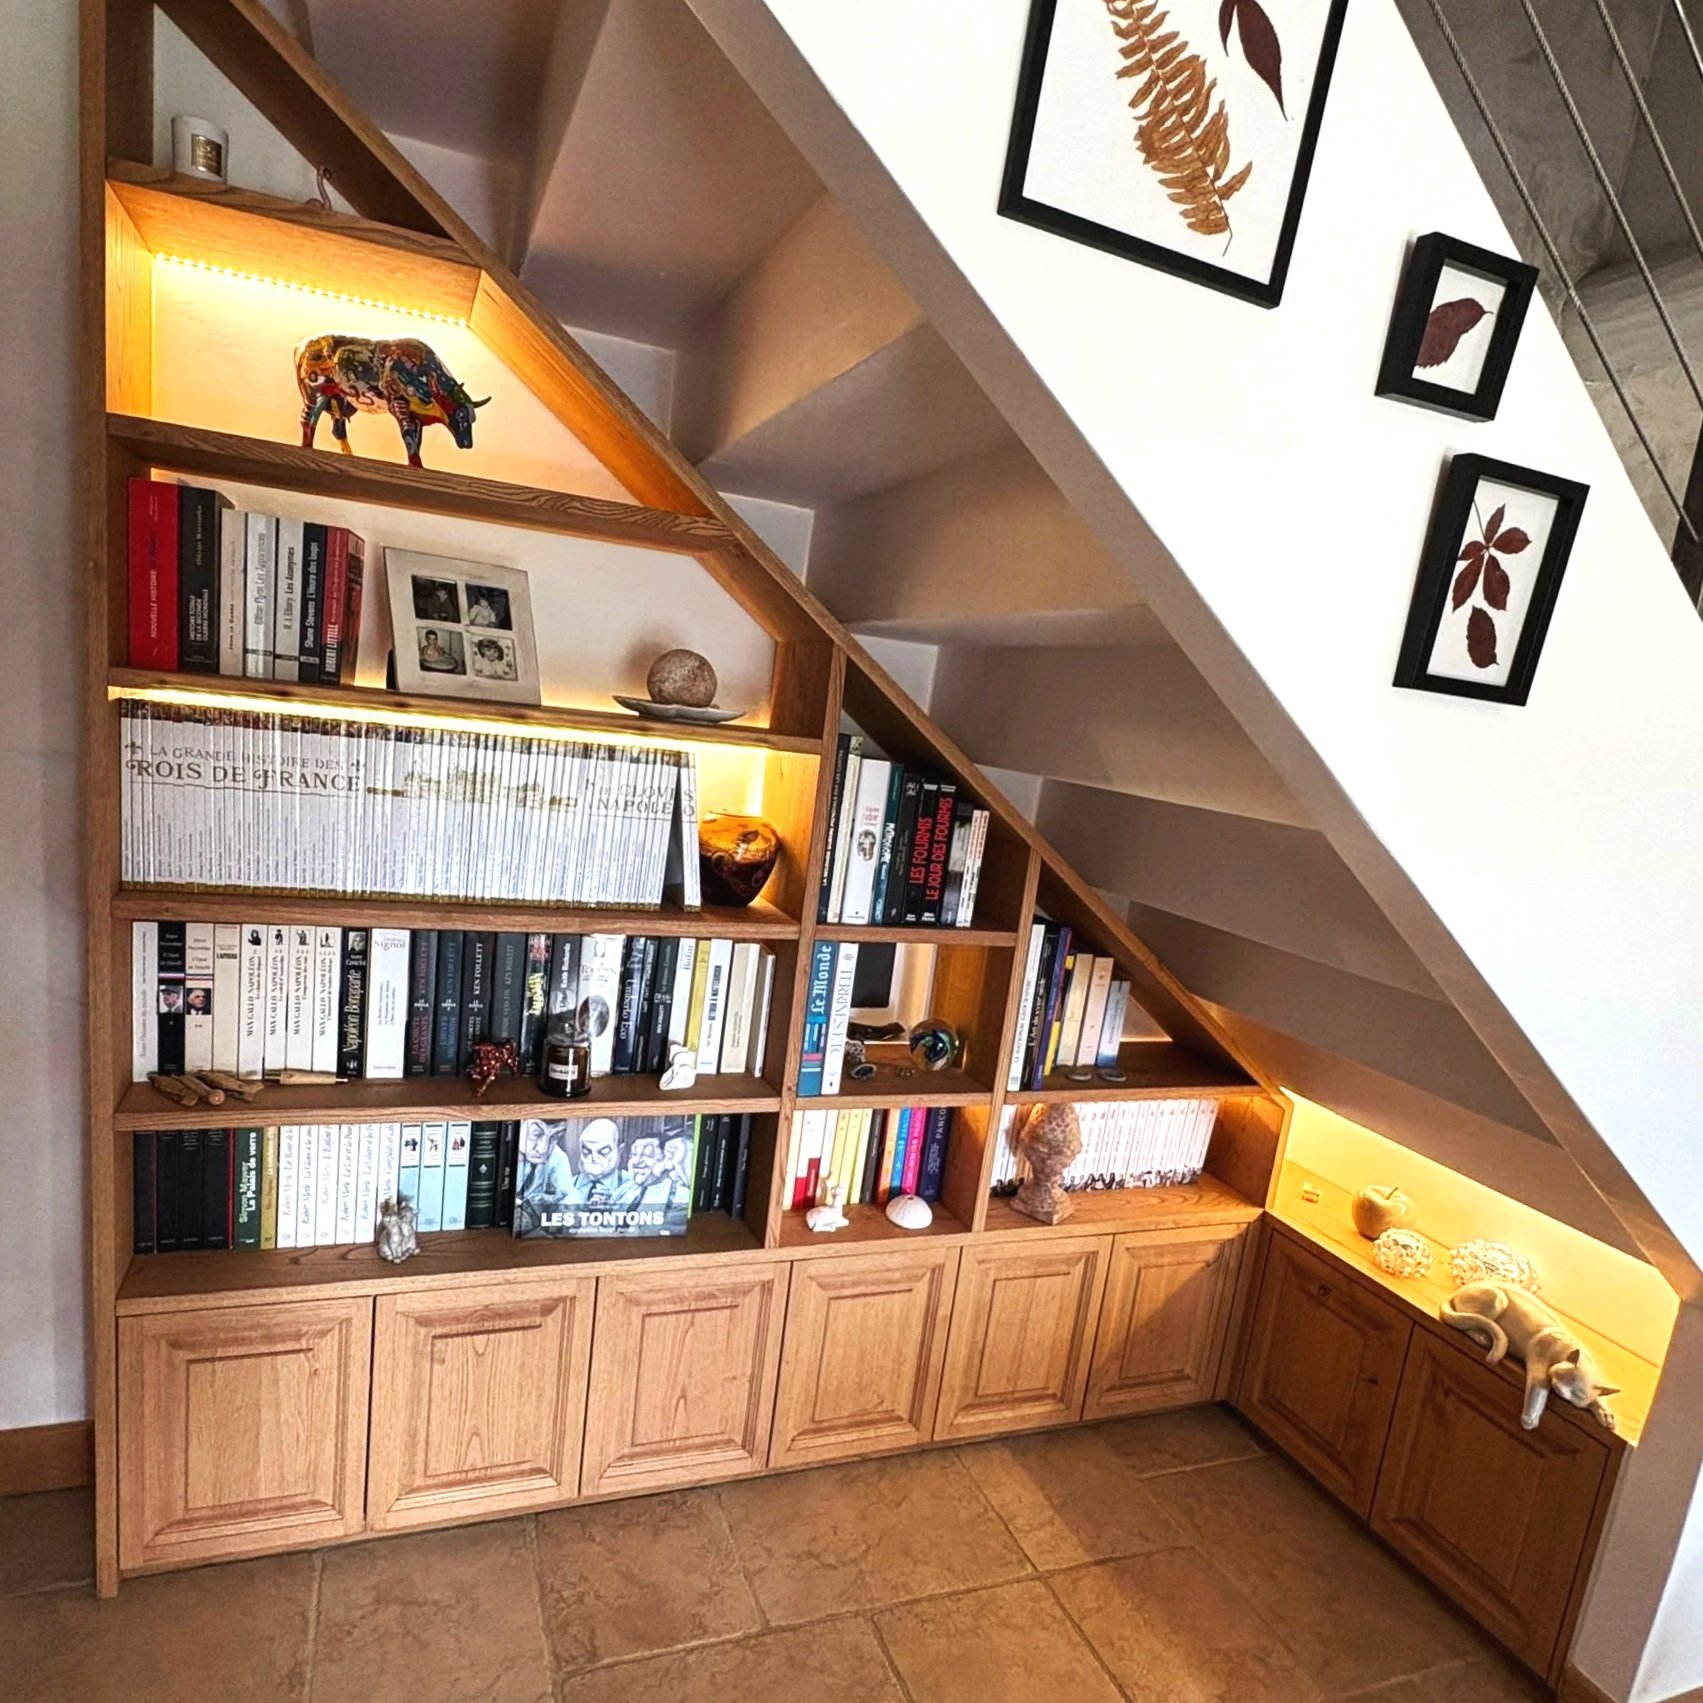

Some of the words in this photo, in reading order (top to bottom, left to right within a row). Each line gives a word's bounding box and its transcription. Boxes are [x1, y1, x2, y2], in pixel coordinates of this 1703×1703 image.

[308, 542, 319, 560] loups
[285, 547, 297, 581] Anonymes
[308, 562, 317, 574] des
[284, 582, 294, 595] Les
[306, 601, 316, 627] Stevens
[305, 628, 315, 648] Shane
[326, 623, 339, 648] LITTELL
[325, 648, 336, 672] ROBERT
[150, 744, 168, 757] LA
[173, 747, 235, 762] GRANDE
[242, 752, 310, 768] HISTOIRE
[126, 759, 203, 781] ROIS
[212, 766, 246, 783] DE
[253, 767, 360, 793] FRANCE
[934, 797, 953, 841] FOURMIS
[912, 816, 933, 864] FOURMIS
[932, 843, 945, 861] DES
[909, 867, 925, 883] LES
[928, 863, 942, 888] JOUR
[926, 889, 938, 900] LE
[420, 941, 428, 977] FOLLETT
[475, 942, 484, 978] FOLLETT
[561, 943, 571, 970] Richards
[560, 972, 568, 988] Keith
[812, 946, 831, 998] Monde
[344, 970, 363, 1013] Bonaparte
[621, 979, 638, 1019] Umberto
[832, 968, 854, 1030] TERRINES
[247, 996, 255, 1021] GALLO
[270, 995, 278, 1019] GALLO
[293, 996, 302, 1019] GALLO
[811, 999, 825, 1014] Le
[293, 1021, 301, 1035] MAX
[343, 1014, 362, 1053] Napoléon
[619, 1021, 632, 1040] Eco
[935, 1109, 946, 1139] PANCO
[249, 1132, 257, 1156] verre
[247, 1157, 256, 1168] de
[247, 1170, 256, 1198] Palais
[239, 1195, 248, 1223] Simon
[247, 1200, 256, 1211] Le
[540, 1212, 575, 1227] LES
[577, 1211, 665, 1227] TONTONS
